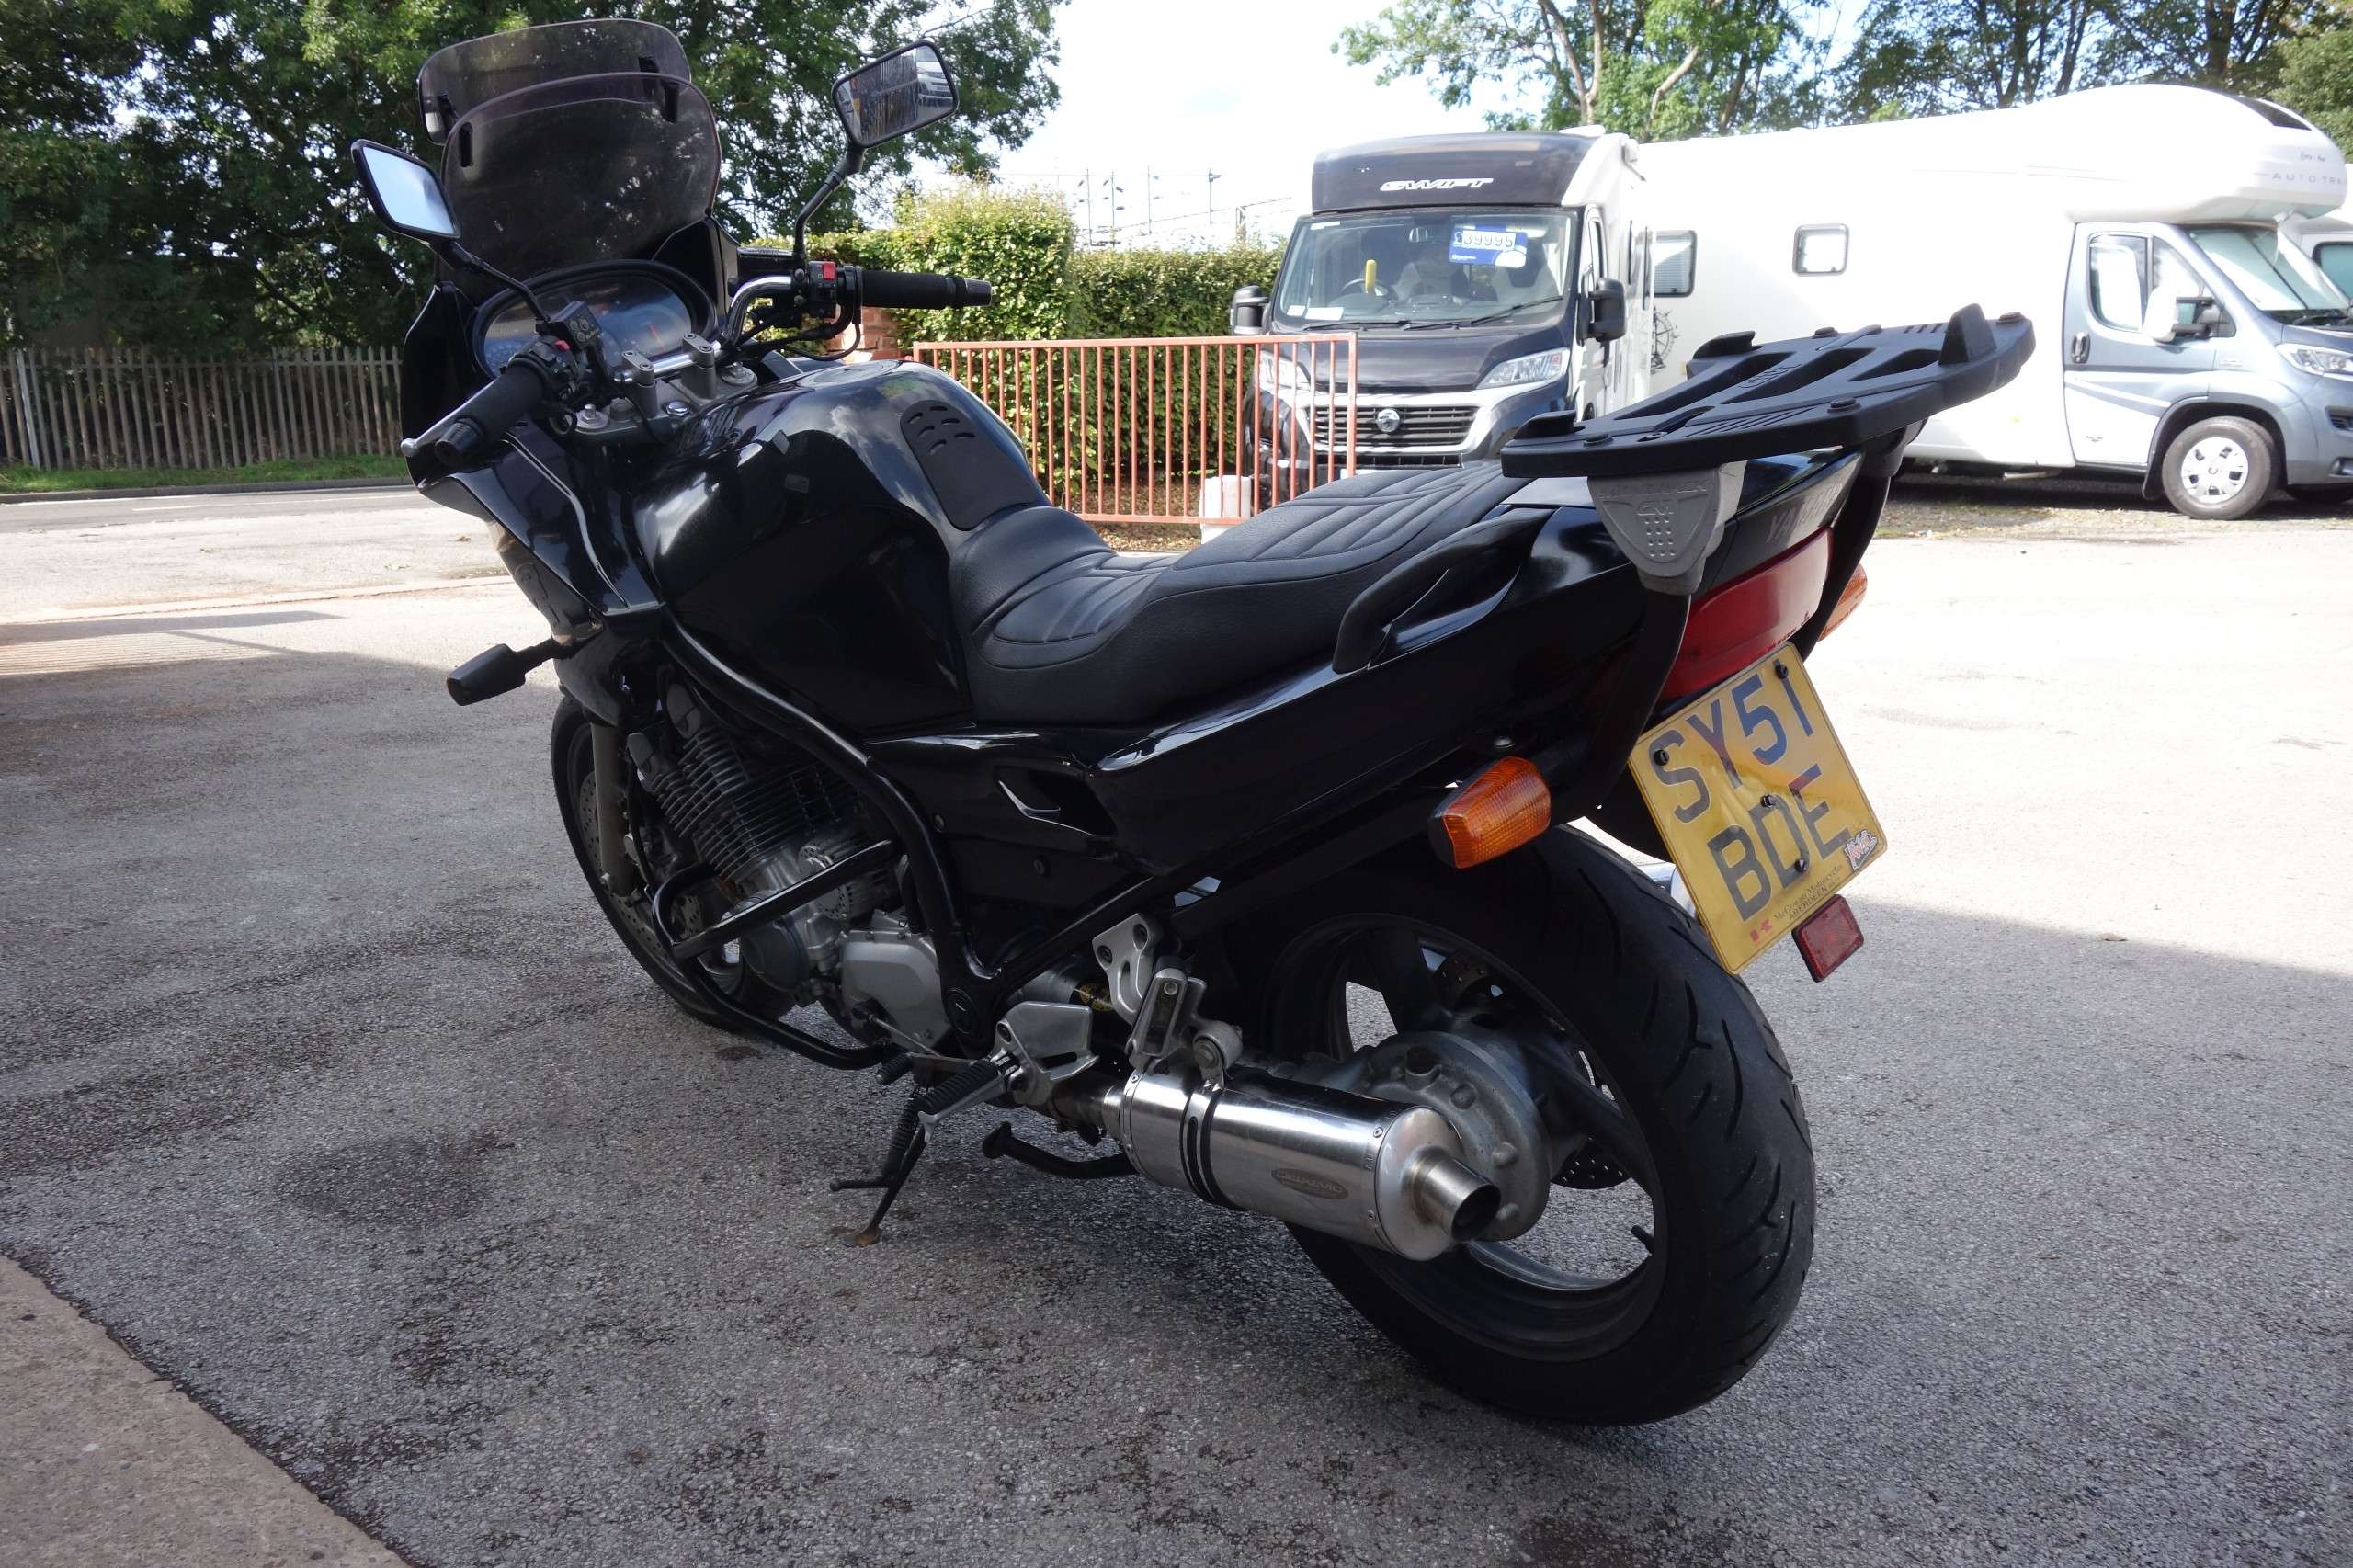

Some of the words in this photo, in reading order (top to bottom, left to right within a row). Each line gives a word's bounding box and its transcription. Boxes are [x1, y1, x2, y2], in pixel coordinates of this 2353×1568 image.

[1380, 178, 1494, 191] SWIFT
[1649, 659, 1813, 823] SY51
[1708, 765, 1850, 921] BDE
